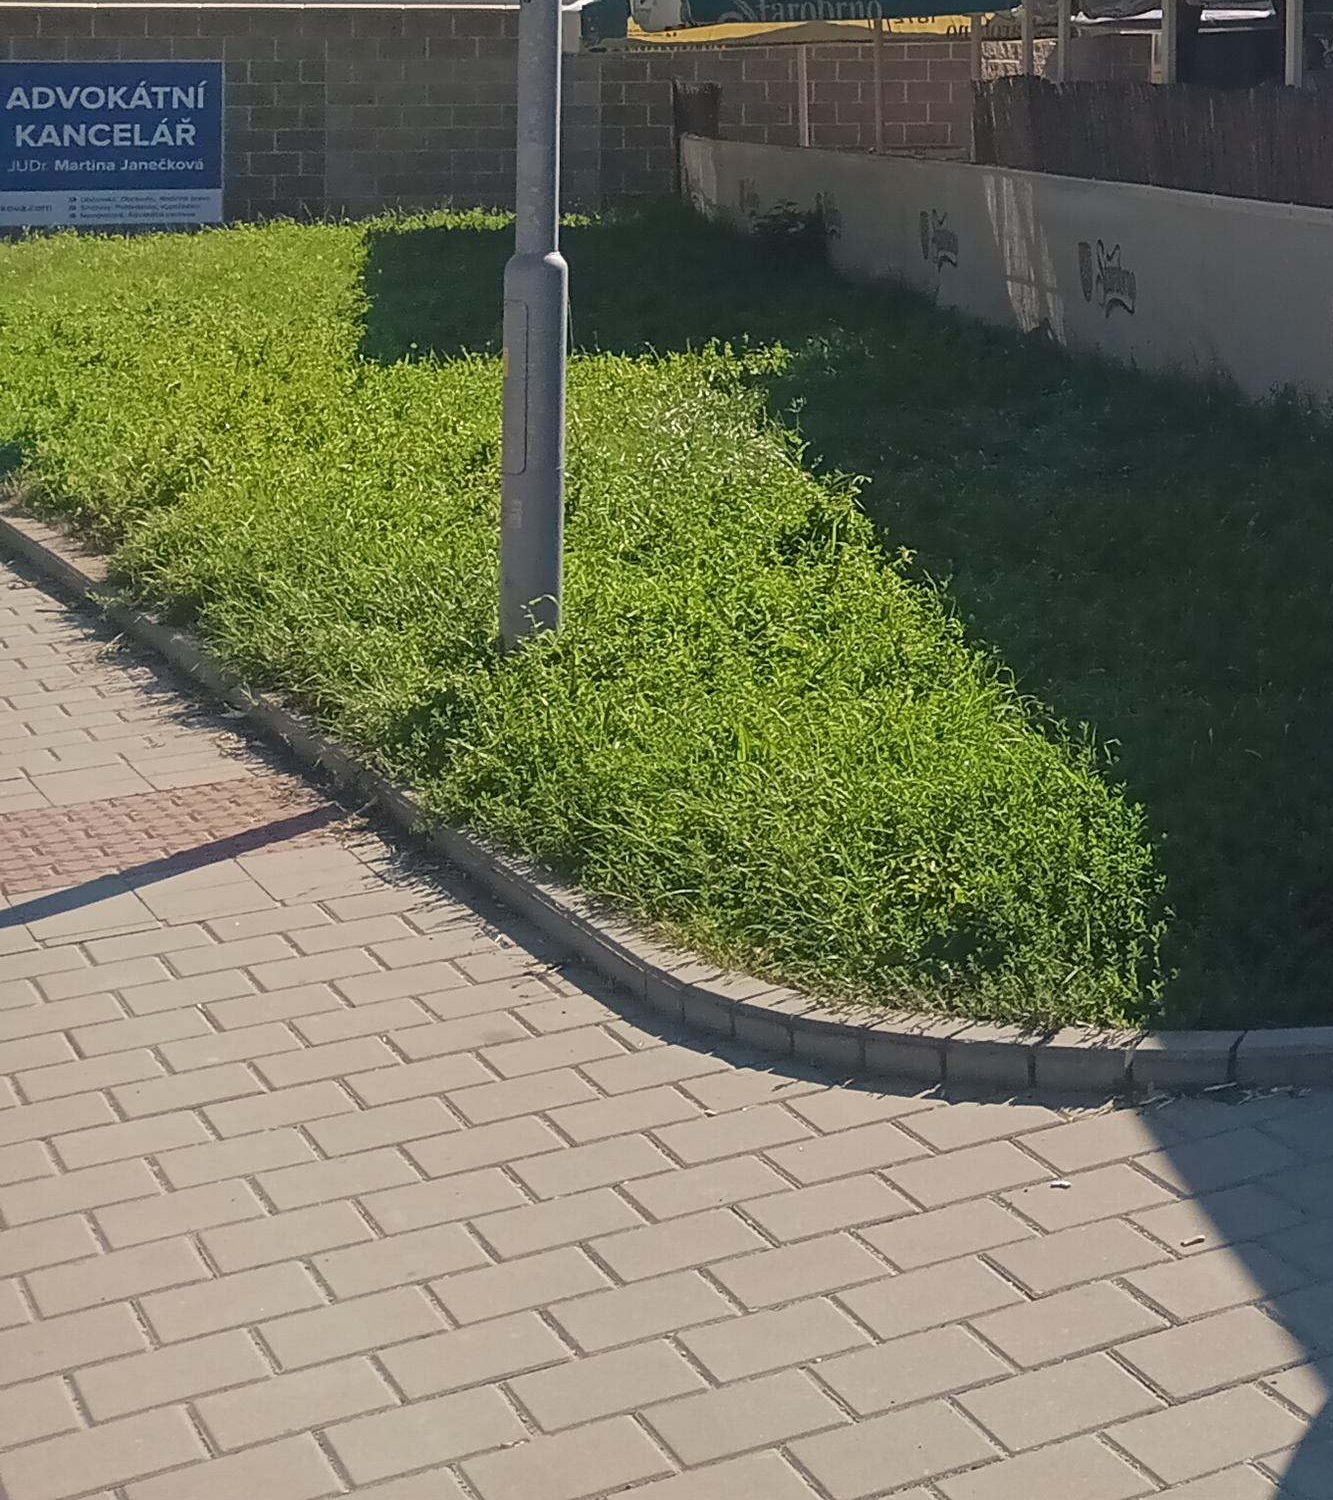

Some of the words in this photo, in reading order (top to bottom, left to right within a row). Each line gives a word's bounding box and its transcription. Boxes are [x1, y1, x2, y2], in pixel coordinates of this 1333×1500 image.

[5, 81, 208, 110] ADVOKÁTNÍ
[15, 117, 196, 147] KANCELÁŘ
[54, 159, 115, 172] Martina
[120, 157, 204, 172] Janečková
